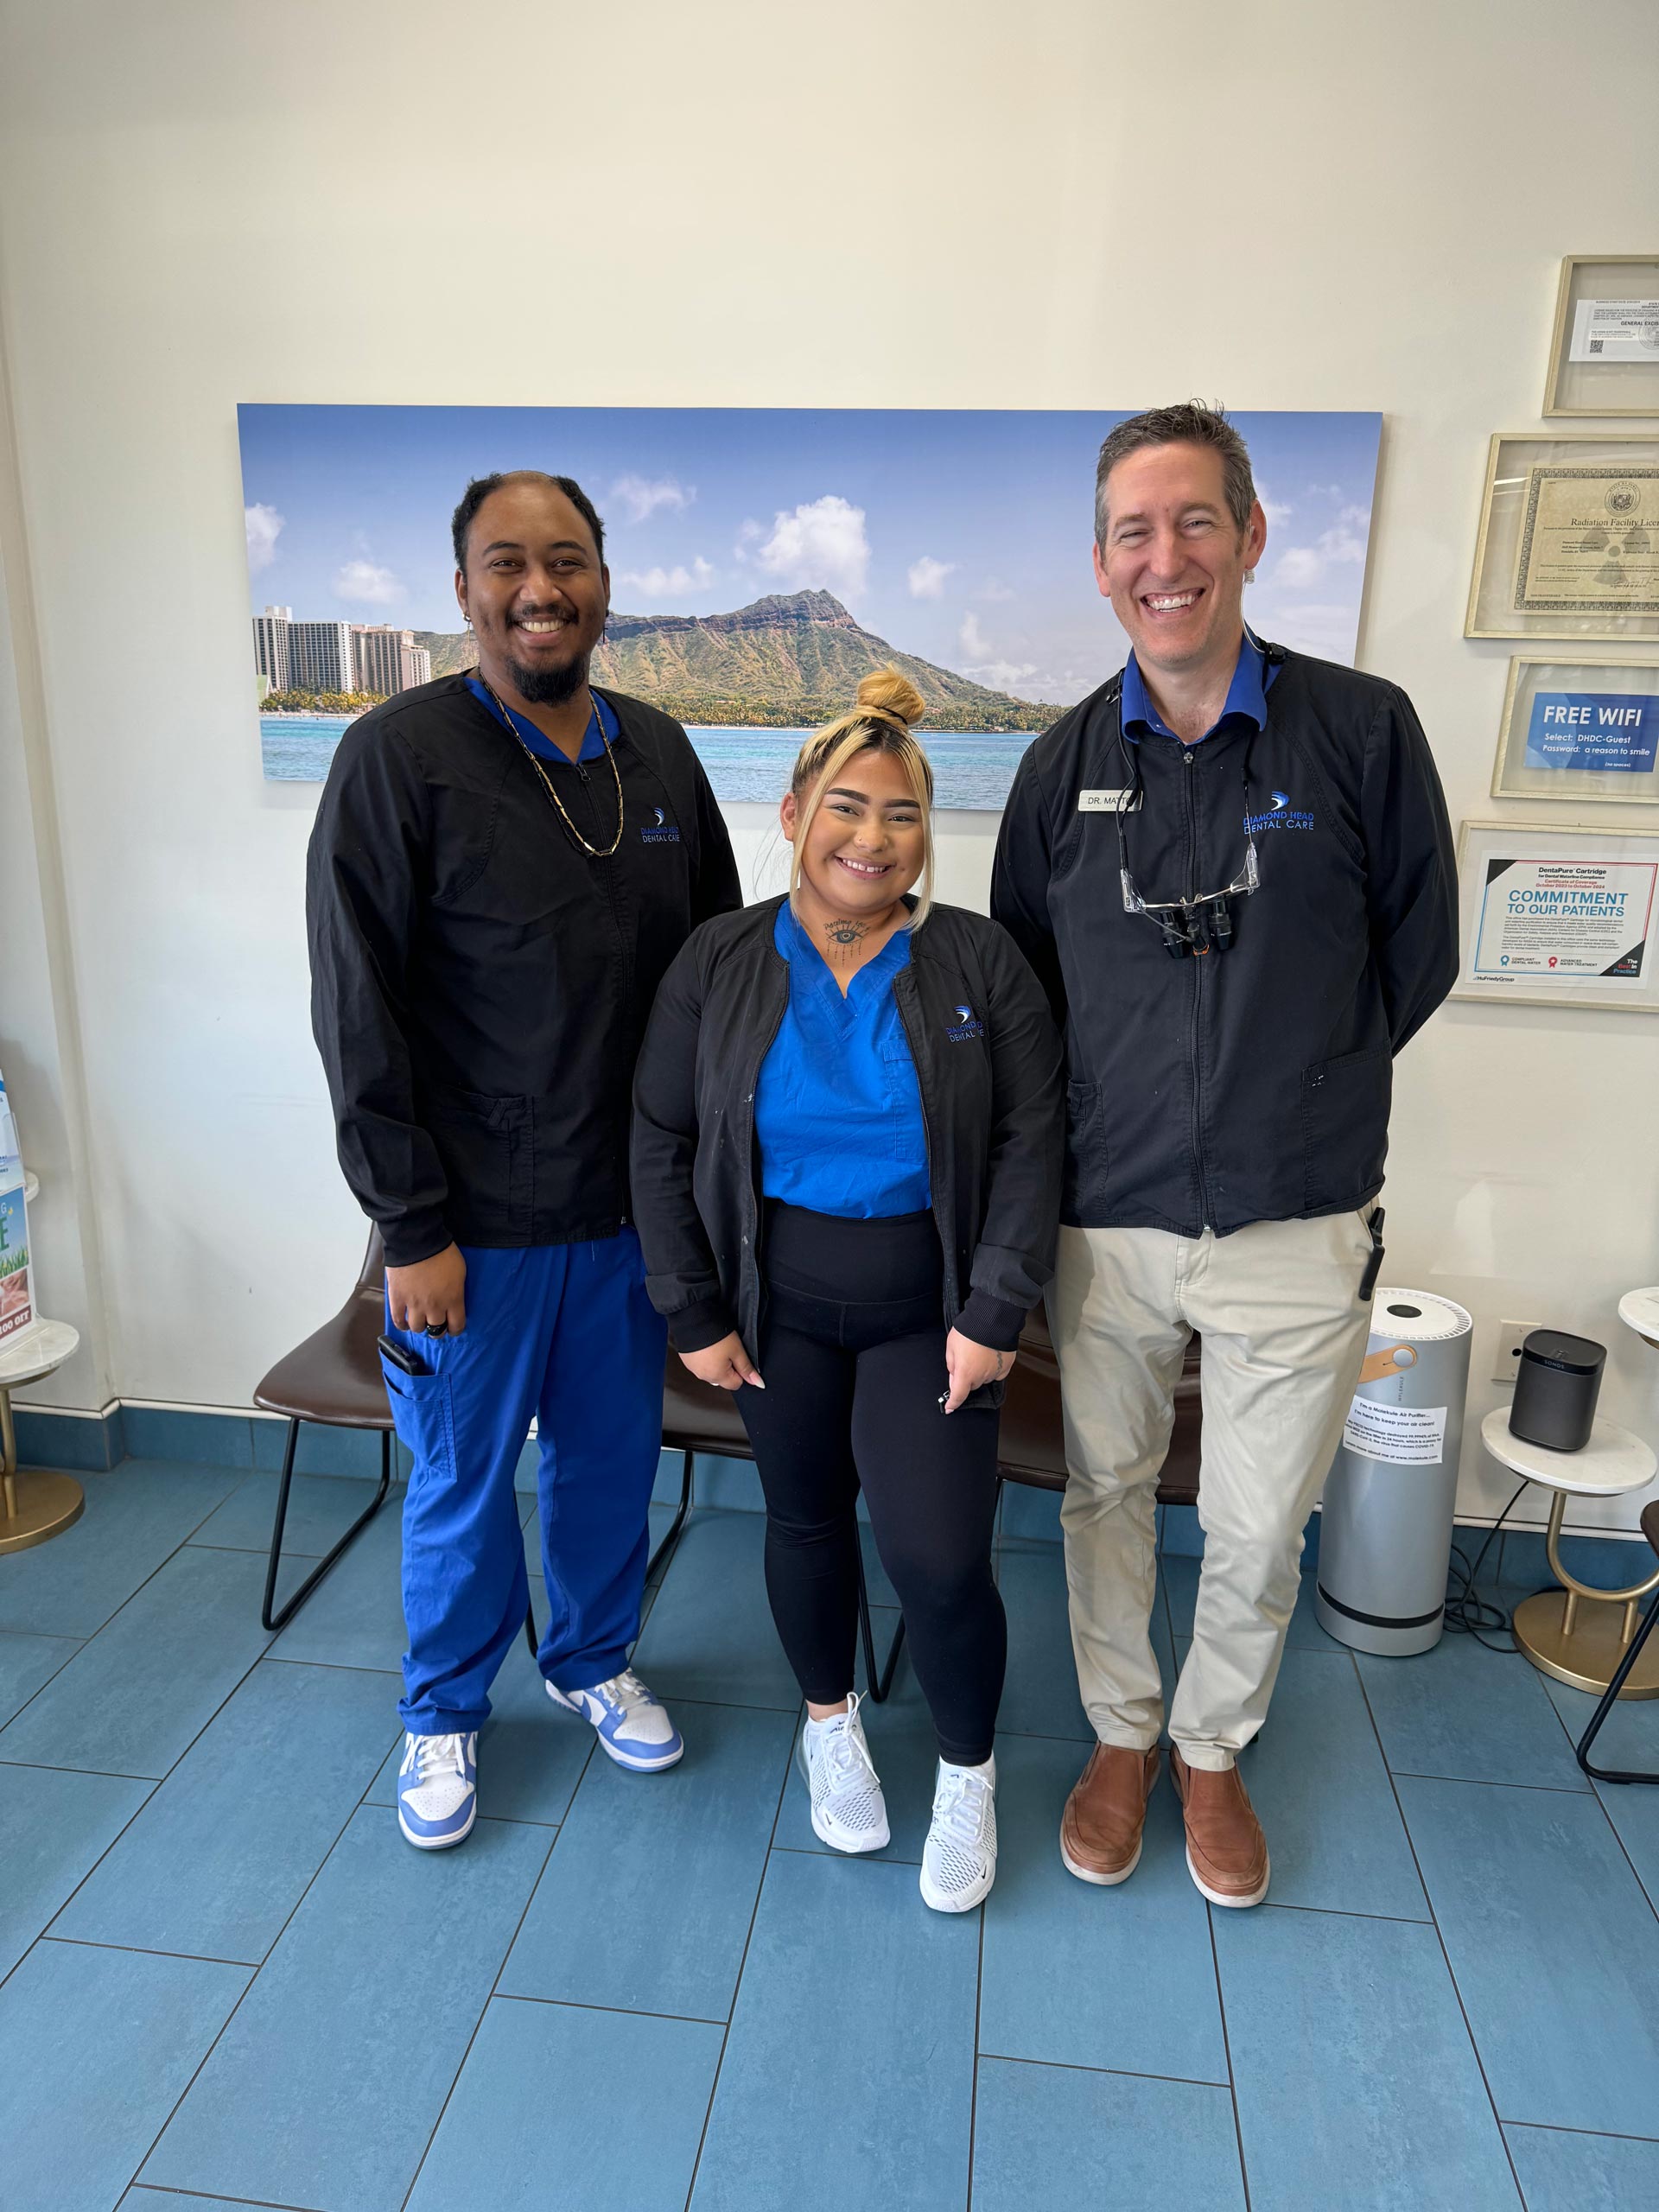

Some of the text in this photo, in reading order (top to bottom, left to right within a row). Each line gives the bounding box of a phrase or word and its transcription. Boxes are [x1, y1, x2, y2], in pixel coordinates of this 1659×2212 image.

[1611, 518, 1638, 528] Facility
[1543, 705, 1642, 726] FREE WIFI
[1578, 734, 1631, 743] DHDC-Guest
[1543, 745, 1580, 753] Password:
[1243, 811, 1313, 826] DIAMOND HEAD
[1244, 820, 1313, 835] DENTAL CARE
[643, 835, 667, 843] DENTAL
[1509, 890, 1629, 905] COMMITMENT
[1507, 904, 1624, 916] TO OUR PATIENTS
[1544, 1359, 1564, 1369] SONOS
[1374, 1408, 1398, 1416] Molekule
